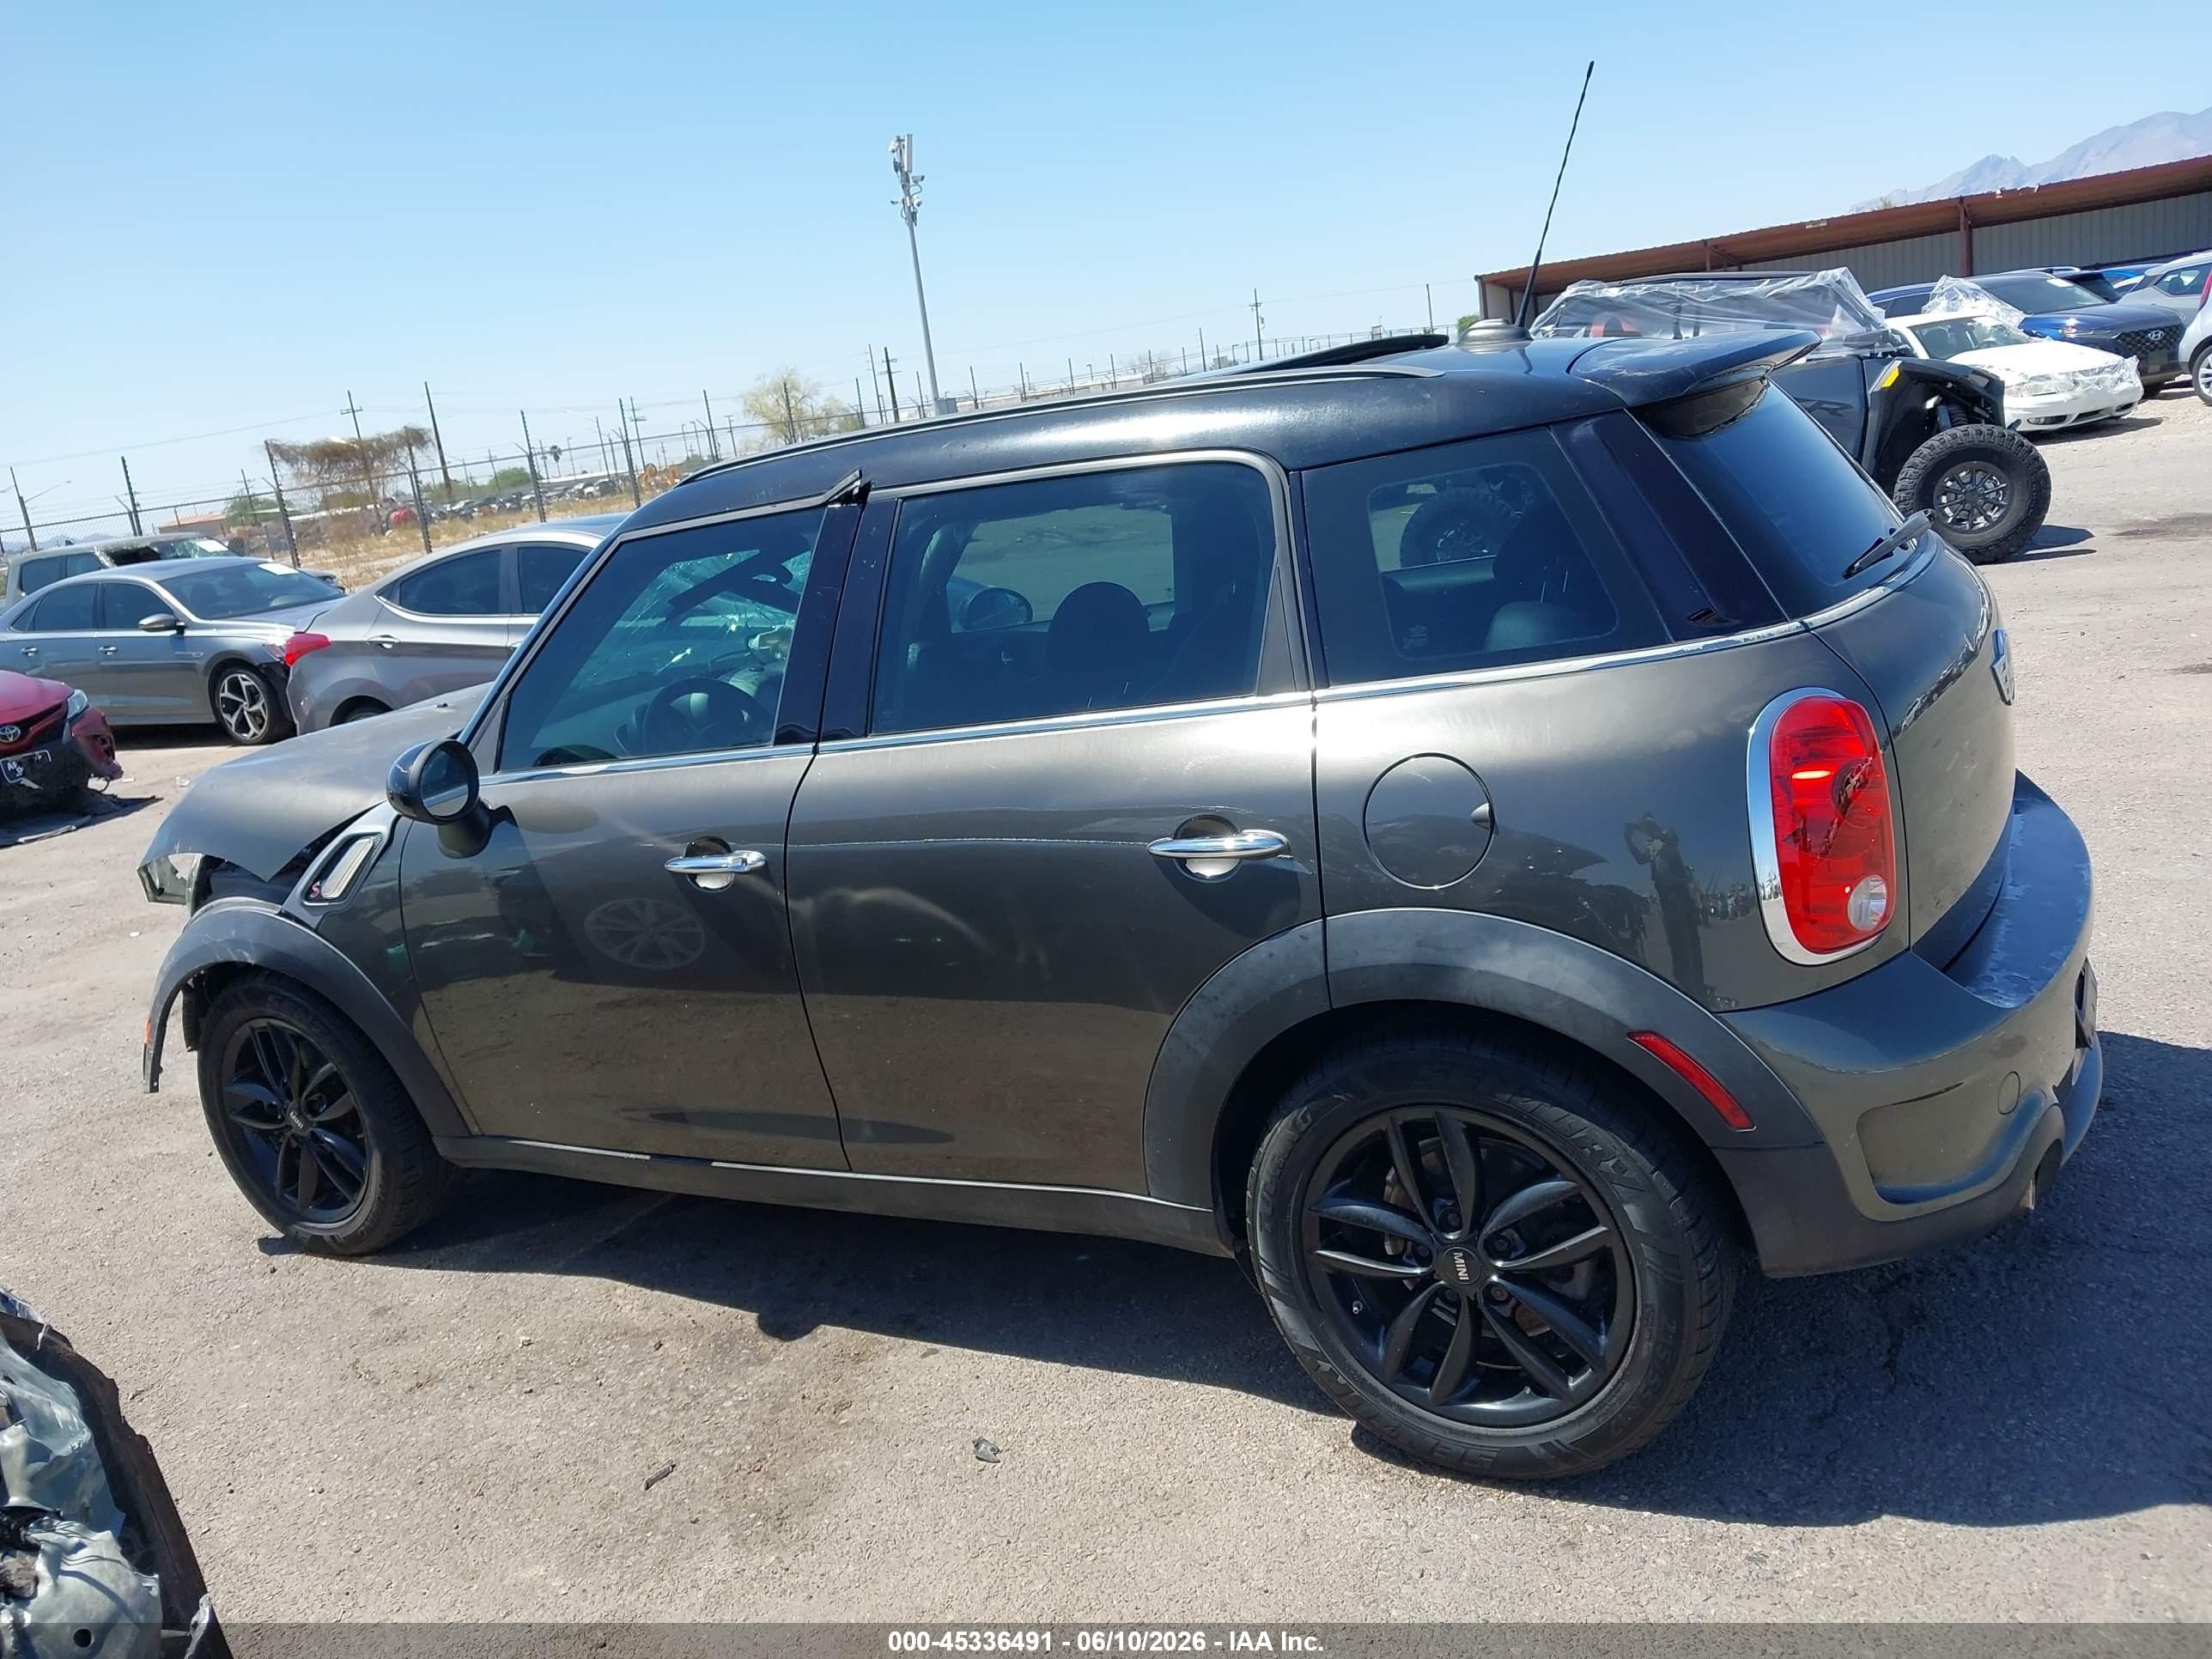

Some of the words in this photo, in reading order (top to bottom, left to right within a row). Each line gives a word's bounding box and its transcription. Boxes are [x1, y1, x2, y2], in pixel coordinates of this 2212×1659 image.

[309, 880, 321, 899] S
[289, 1109, 305, 1130] MINI
[1452, 1252, 1471, 1280] MINI
